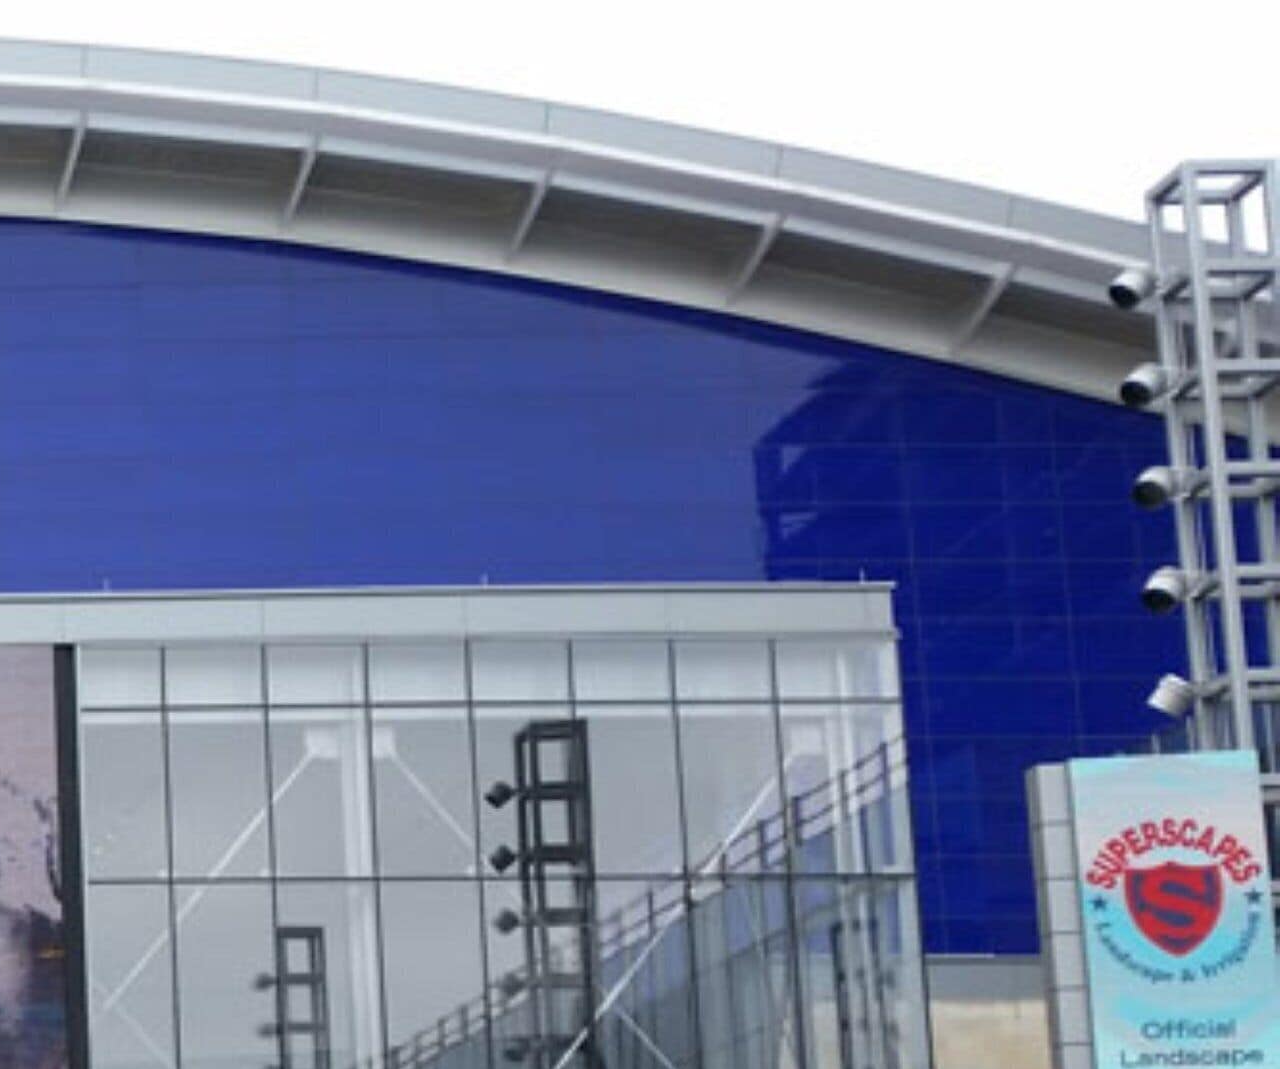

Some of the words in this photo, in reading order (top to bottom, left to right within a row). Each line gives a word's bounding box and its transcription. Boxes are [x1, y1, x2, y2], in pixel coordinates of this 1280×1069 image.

[1086, 818, 1262, 889] SUPERSCAPES
[1142, 1018, 1236, 1038] Official
[1120, 1049, 1264, 1068] Landscape
